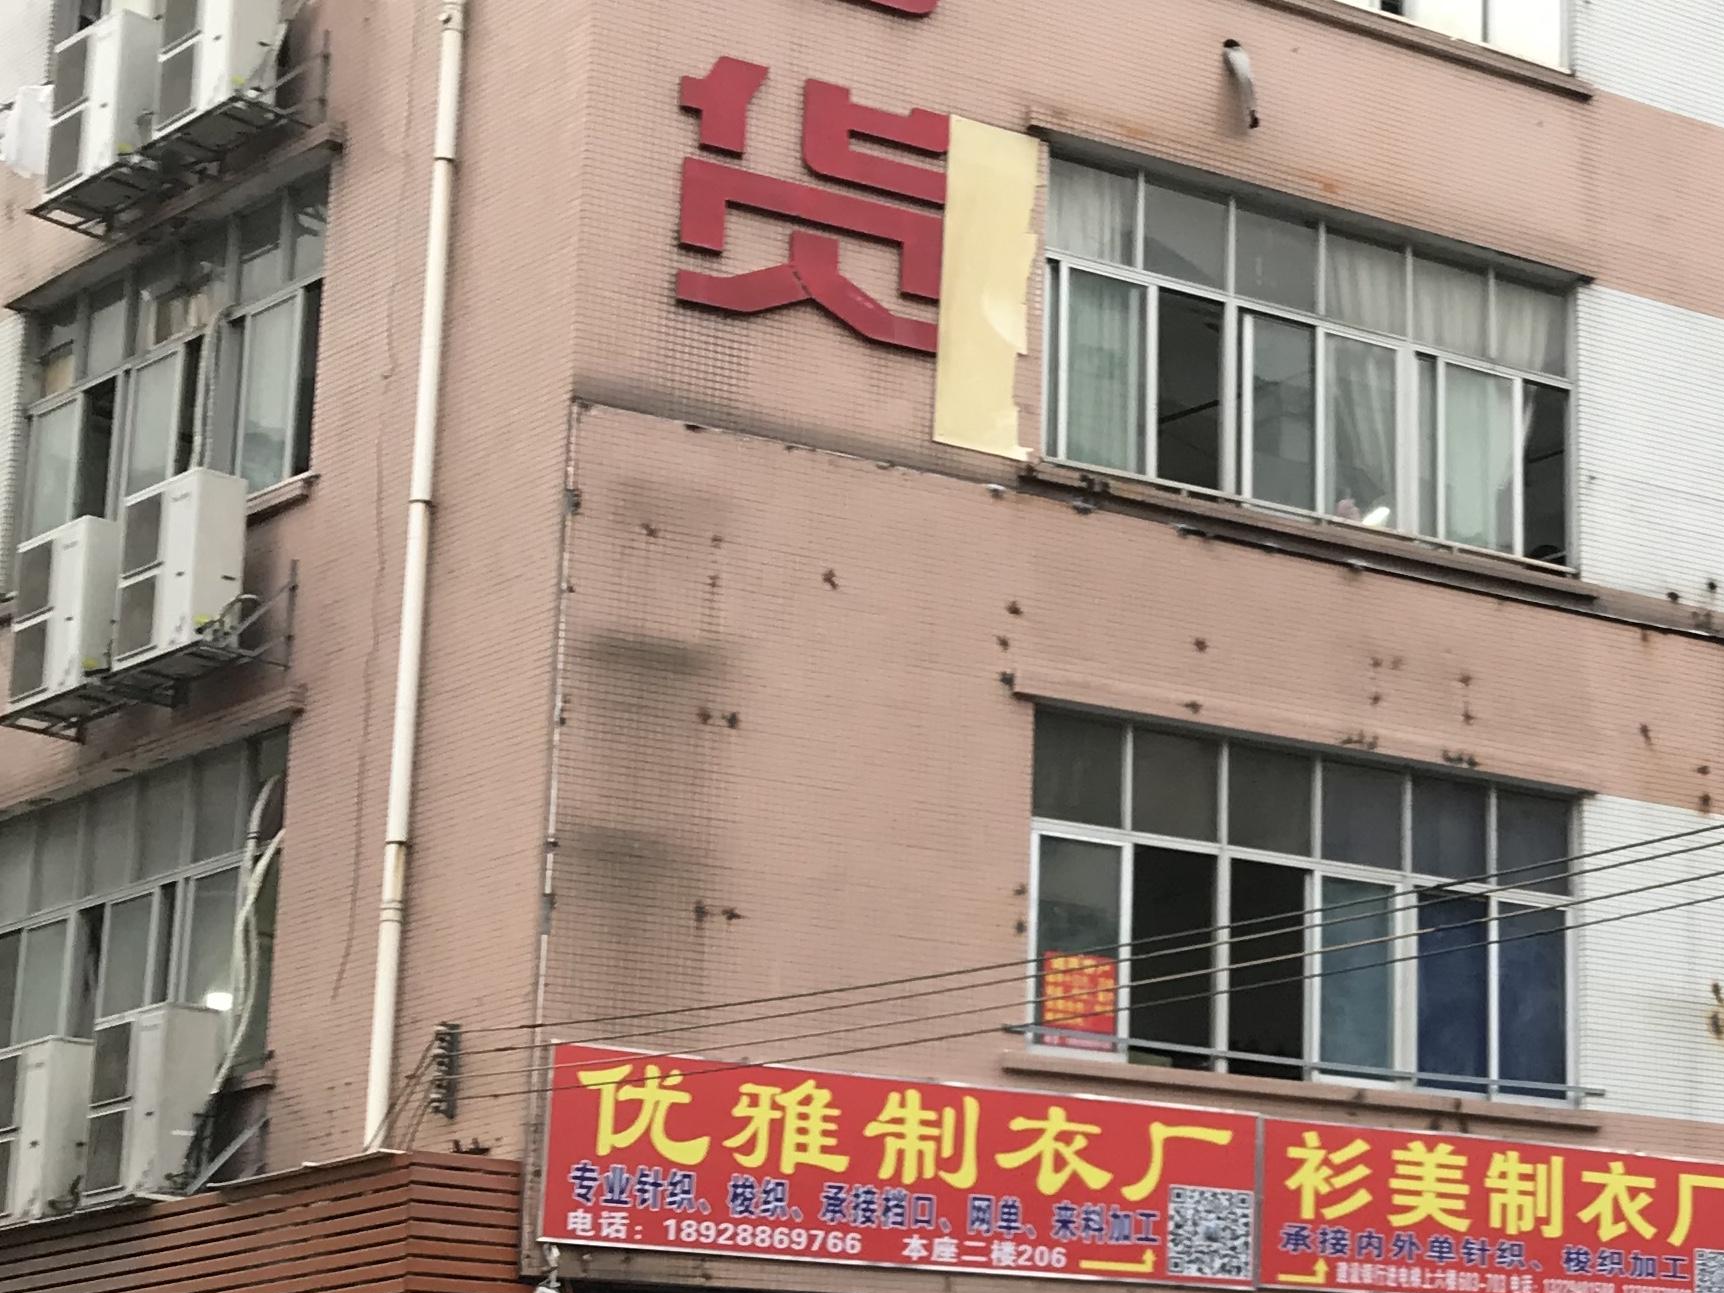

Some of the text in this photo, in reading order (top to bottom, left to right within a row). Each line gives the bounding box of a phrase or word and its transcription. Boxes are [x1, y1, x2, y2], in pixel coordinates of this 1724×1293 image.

[577, 1062, 1233, 1202] 优雅制衣厂
